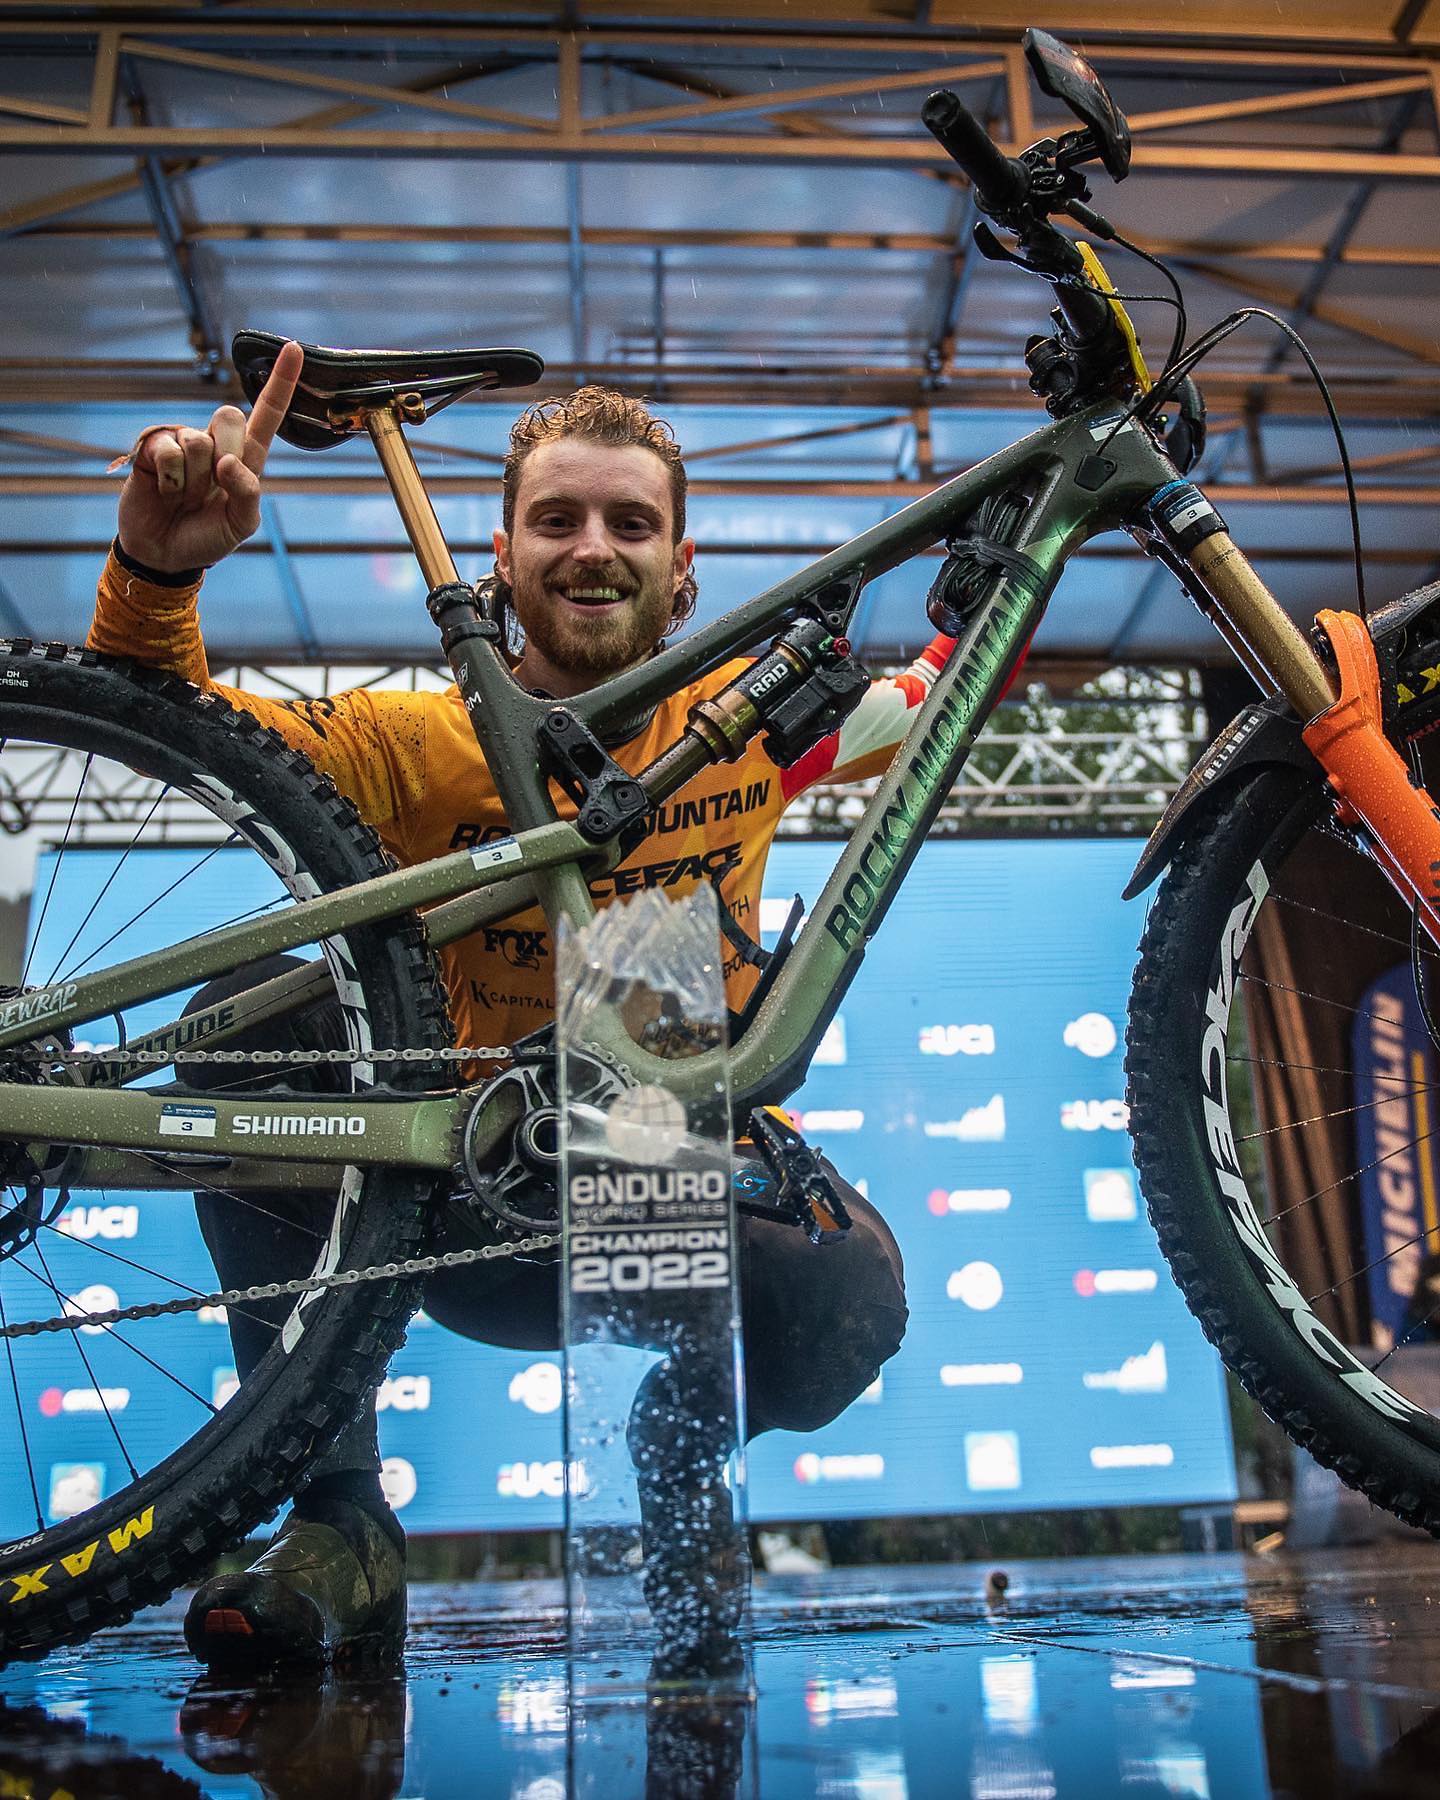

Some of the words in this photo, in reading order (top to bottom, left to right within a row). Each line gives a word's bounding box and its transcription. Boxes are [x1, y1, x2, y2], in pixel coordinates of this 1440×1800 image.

[1186, 509, 1198, 519] 3
[0, 678, 29, 687] ASING
[750, 663, 789, 697] RAD
[640, 778, 771, 837] OUNTAIN
[491, 851, 503, 862] 3
[589, 840, 744, 899] CEFACE
[824, 784, 914, 953] ROCKY
[482, 927, 548, 971] FOX
[181, 1121, 193, 1131] 3
[232, 1115, 365, 1136] SHIMANO
[1073, 1099, 1131, 1131] UC
[71, 1205, 140, 1239] UCI
[571, 1229, 729, 1254] CHAMPION
[571, 1252, 730, 1292] 2022
[0, 1504, 156, 1604] MAX
